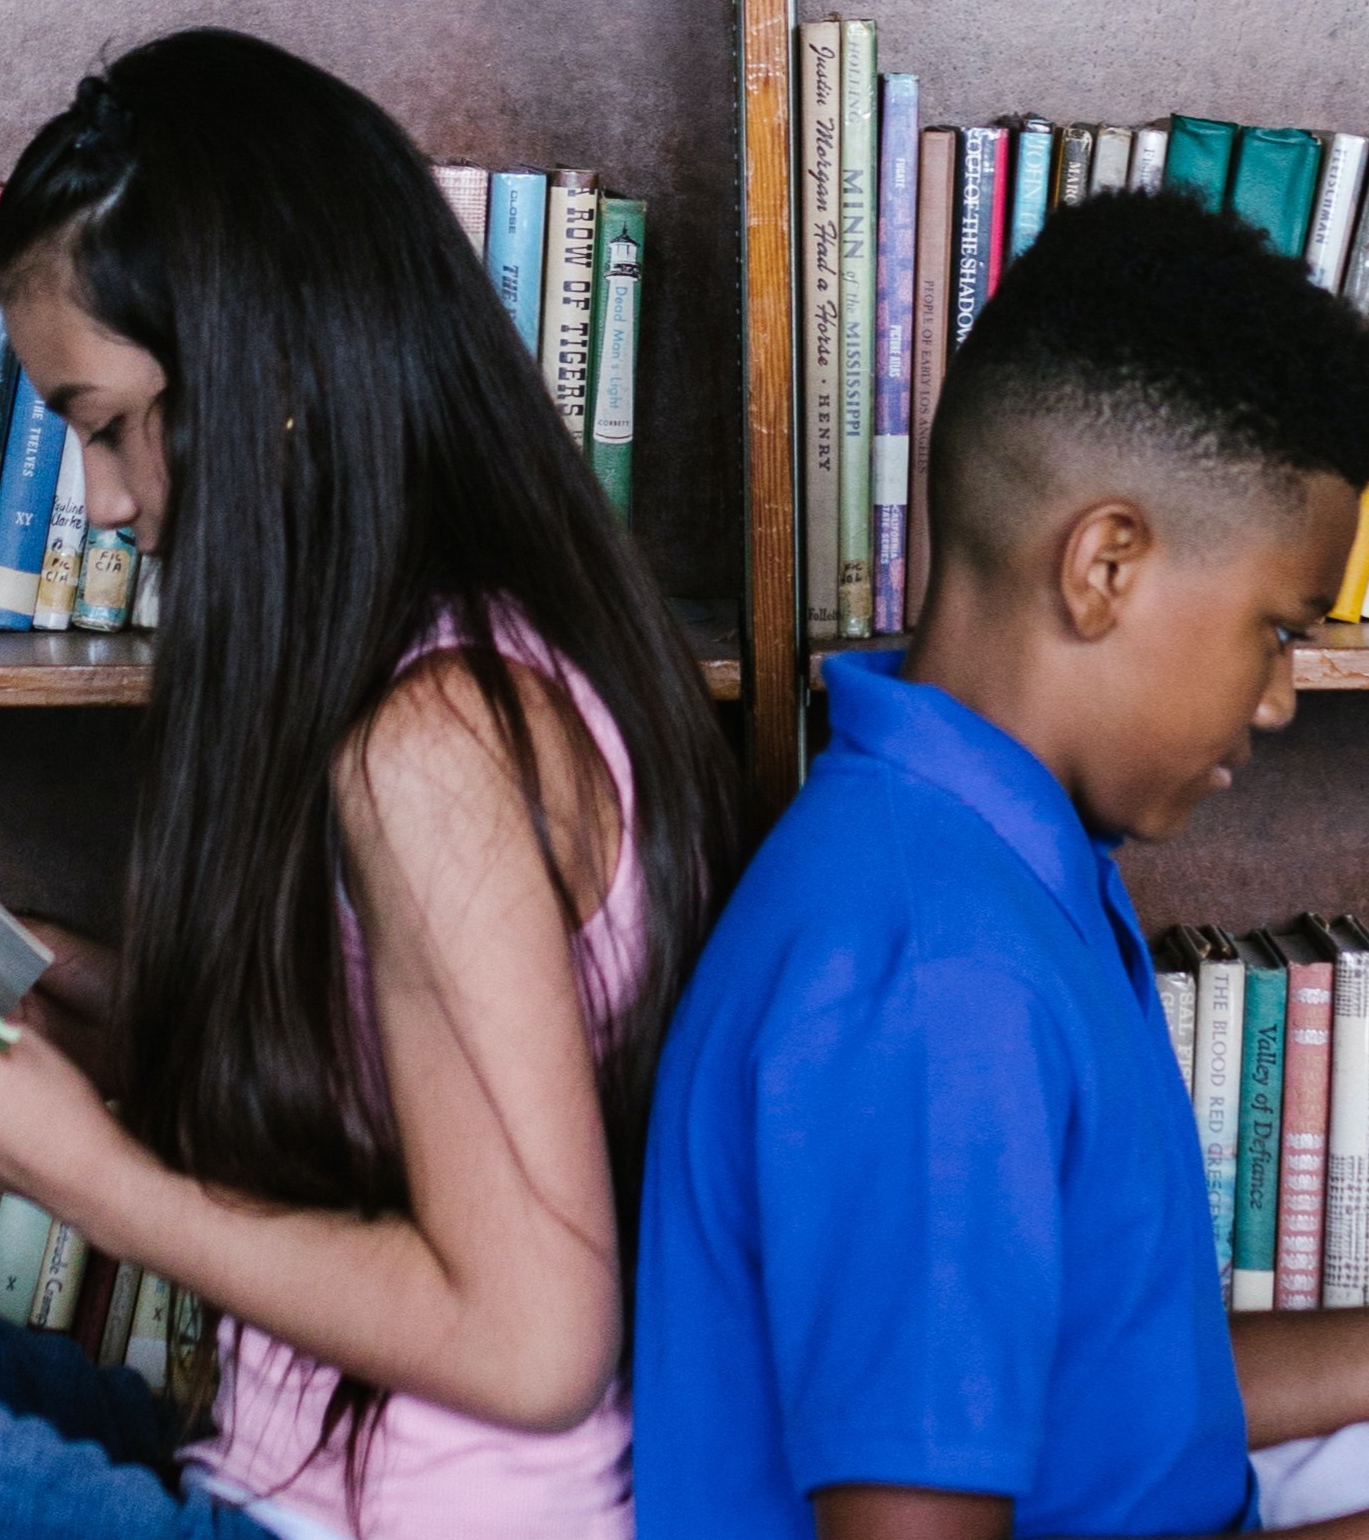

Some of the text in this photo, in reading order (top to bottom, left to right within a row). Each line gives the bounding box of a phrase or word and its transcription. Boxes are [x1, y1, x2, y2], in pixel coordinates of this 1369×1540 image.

[807, 43, 838, 367] Justin Morgan Had a Horse
[842, 169, 866, 259] MINN
[557, 208, 594, 416] ROW OF TIGERS
[608, 287, 627, 409] Dead Man's Light
[817, 395, 832, 472] HENRY
[844, 322, 862, 437] MISSISSIPPI
[1249, 1024, 1277, 1210] Valley of Defiance
